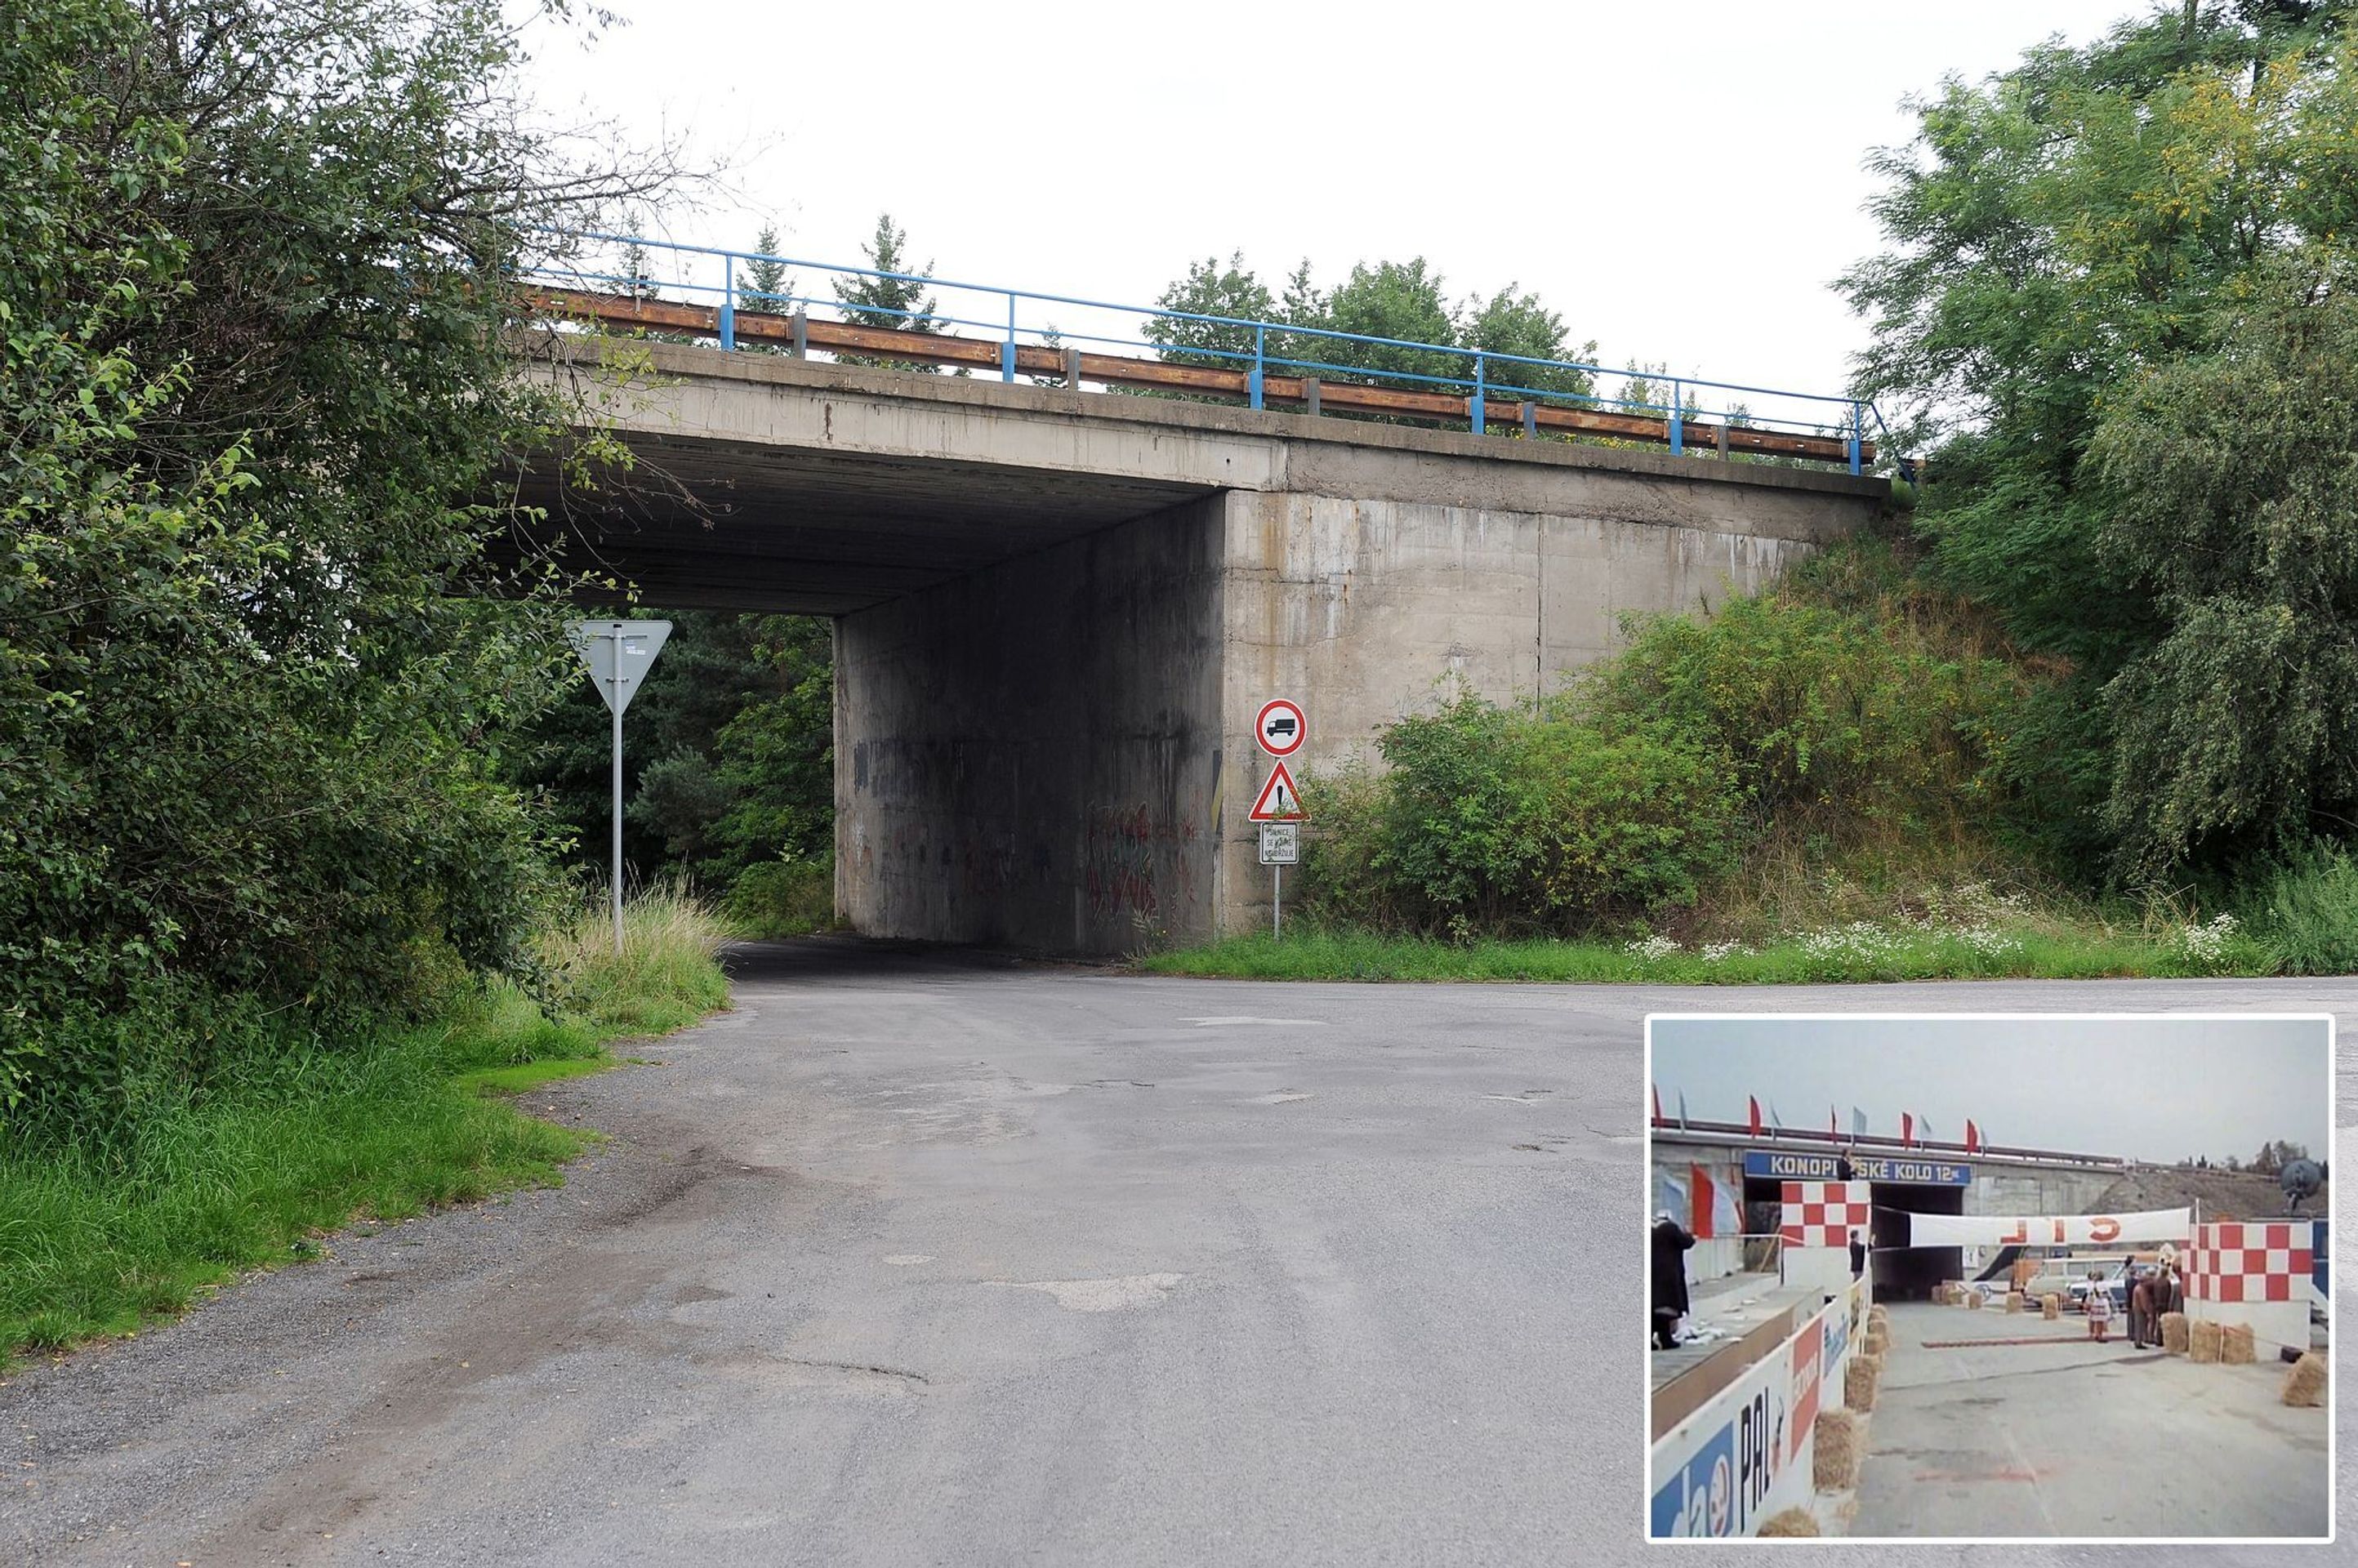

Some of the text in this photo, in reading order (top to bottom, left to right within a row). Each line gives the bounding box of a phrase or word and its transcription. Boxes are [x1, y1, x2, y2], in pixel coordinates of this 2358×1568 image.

[1771, 1156, 1889, 1178] KONOPISKÉ
[1895, 1164, 1932, 1180] KOLO
[1741, 1386, 1770, 1535] PAL
